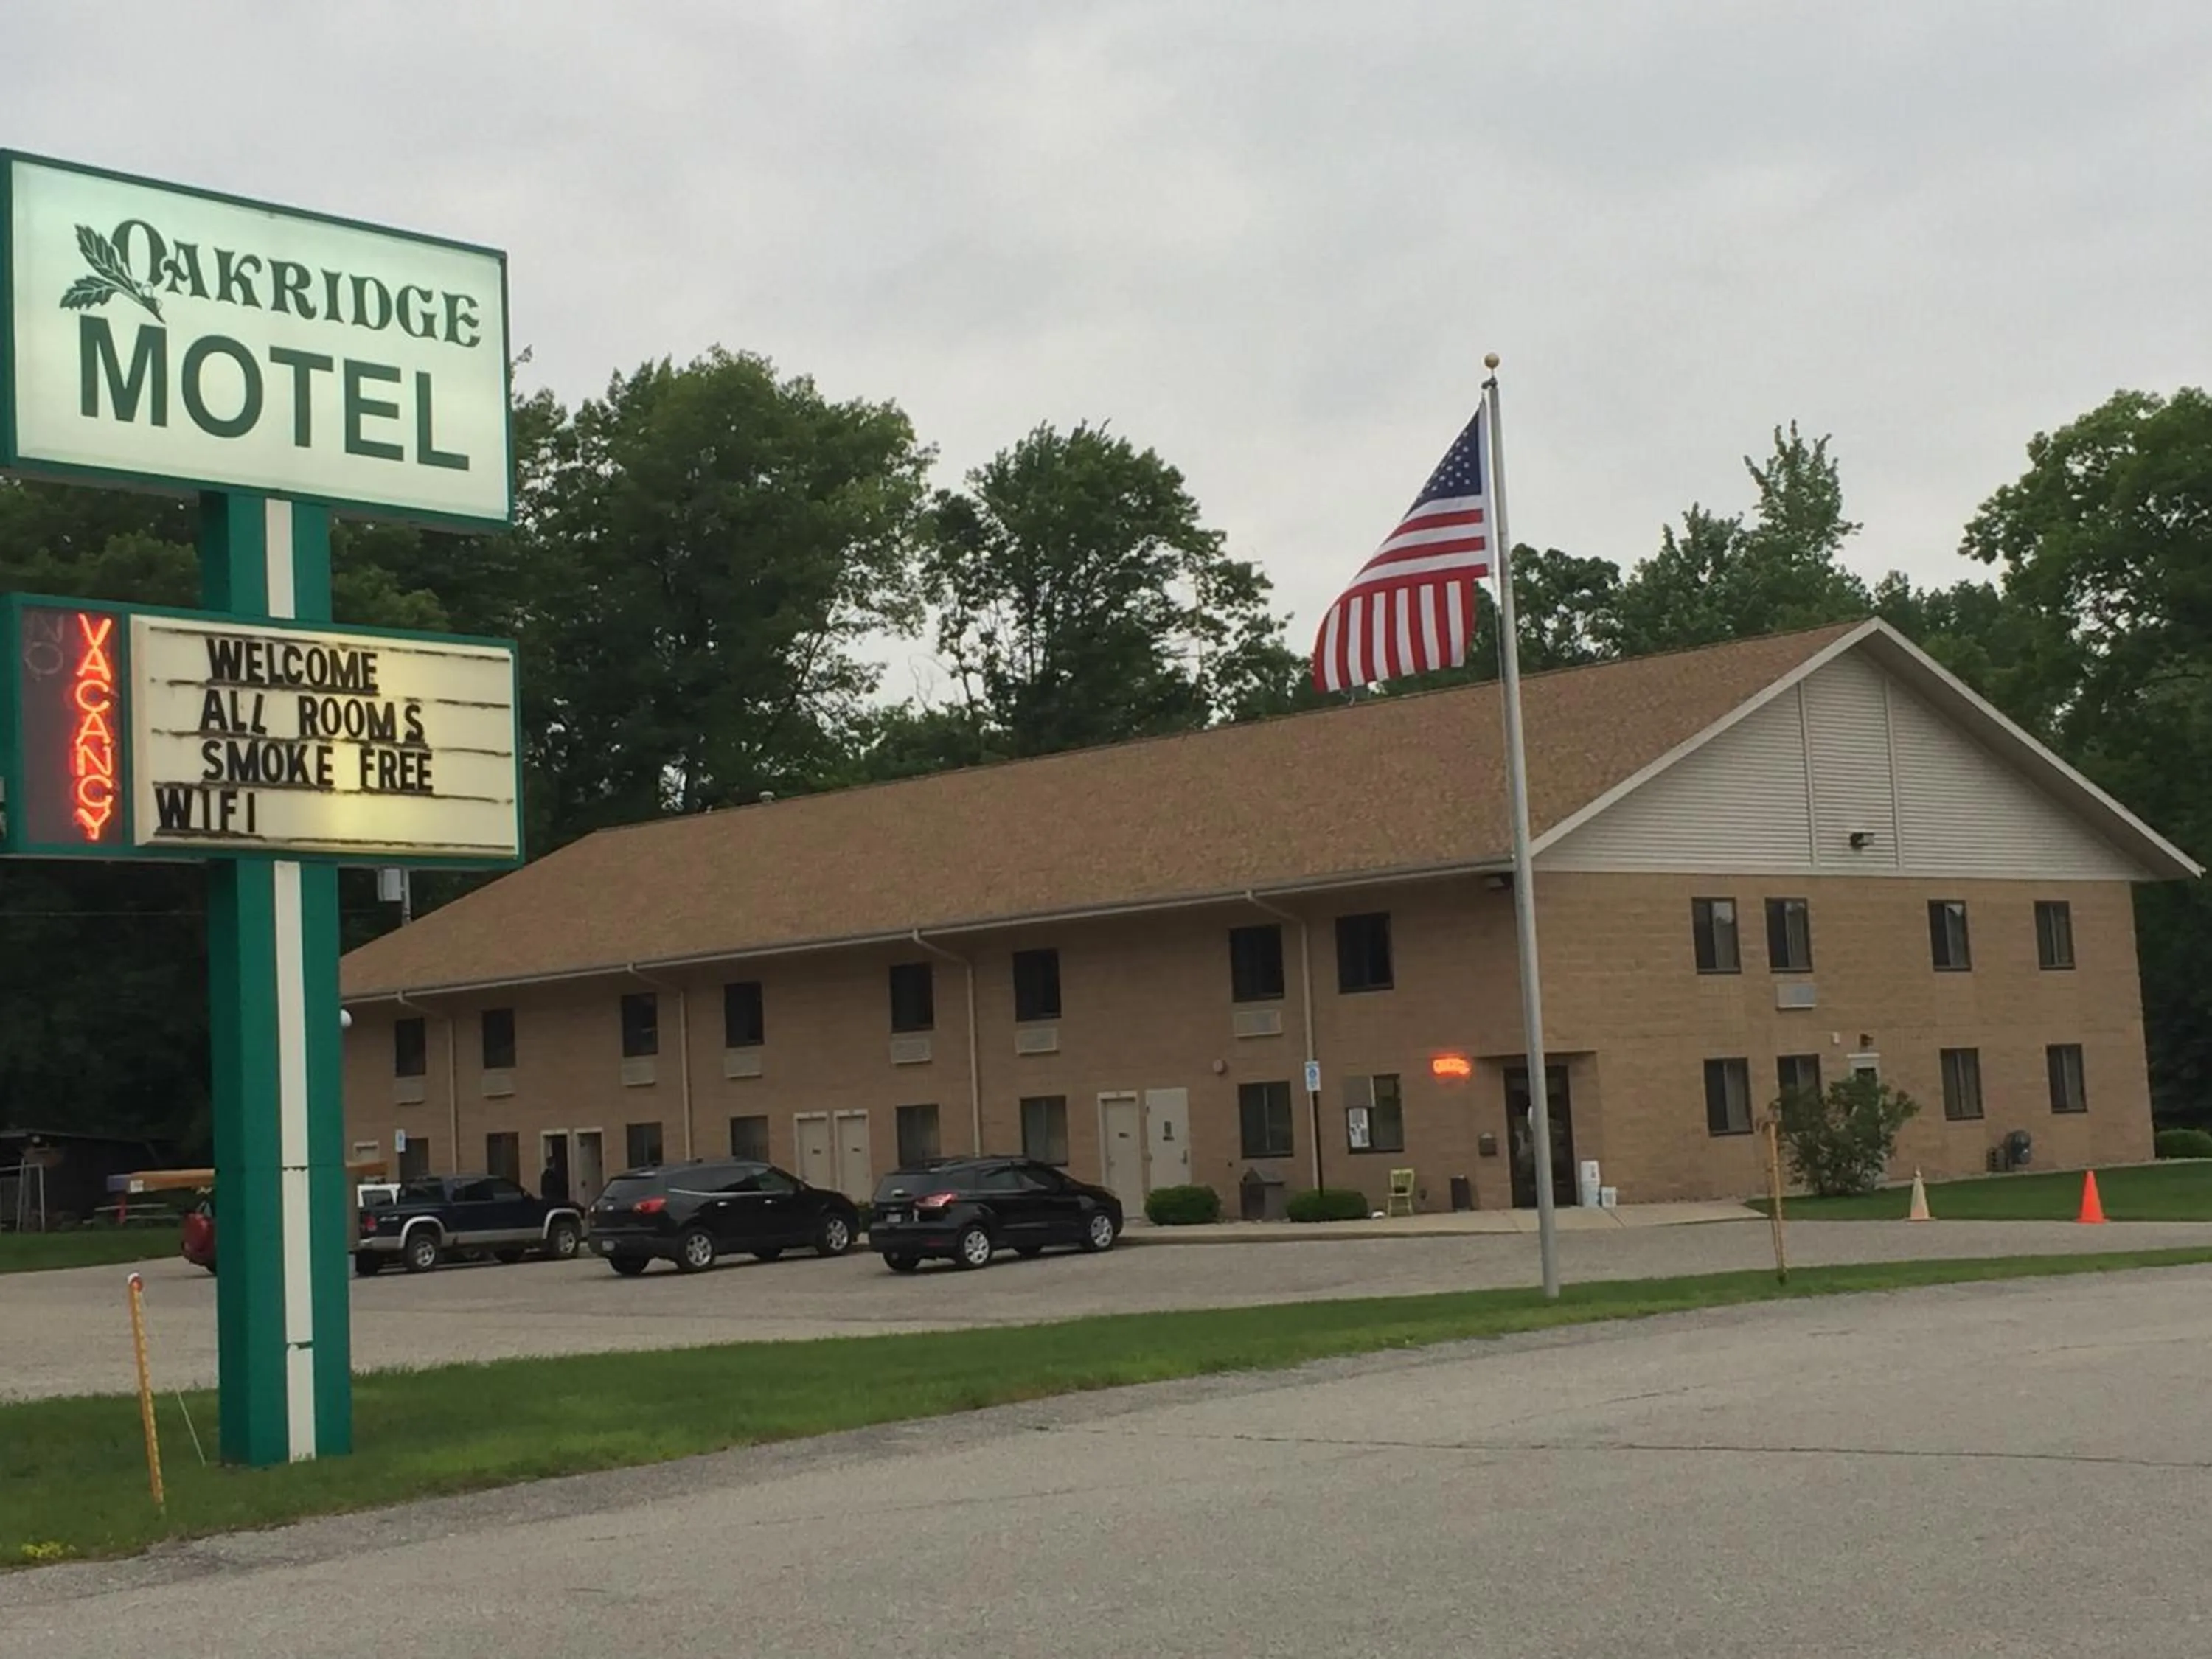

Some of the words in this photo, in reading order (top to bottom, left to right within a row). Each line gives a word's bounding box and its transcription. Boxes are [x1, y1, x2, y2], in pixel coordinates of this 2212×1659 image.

[111, 218, 481, 348] OAKRIDGE
[78, 313, 470, 471] MOTEL
[206, 637, 379, 692] WELCOME
[76, 613, 113, 841] VACANCY
[200, 689, 268, 735] ALL
[298, 695, 425, 743] ROOMS
[201, 740, 334, 786] SMOKE
[360, 748, 434, 792] FREE
[154, 787, 256, 833] WIFI
